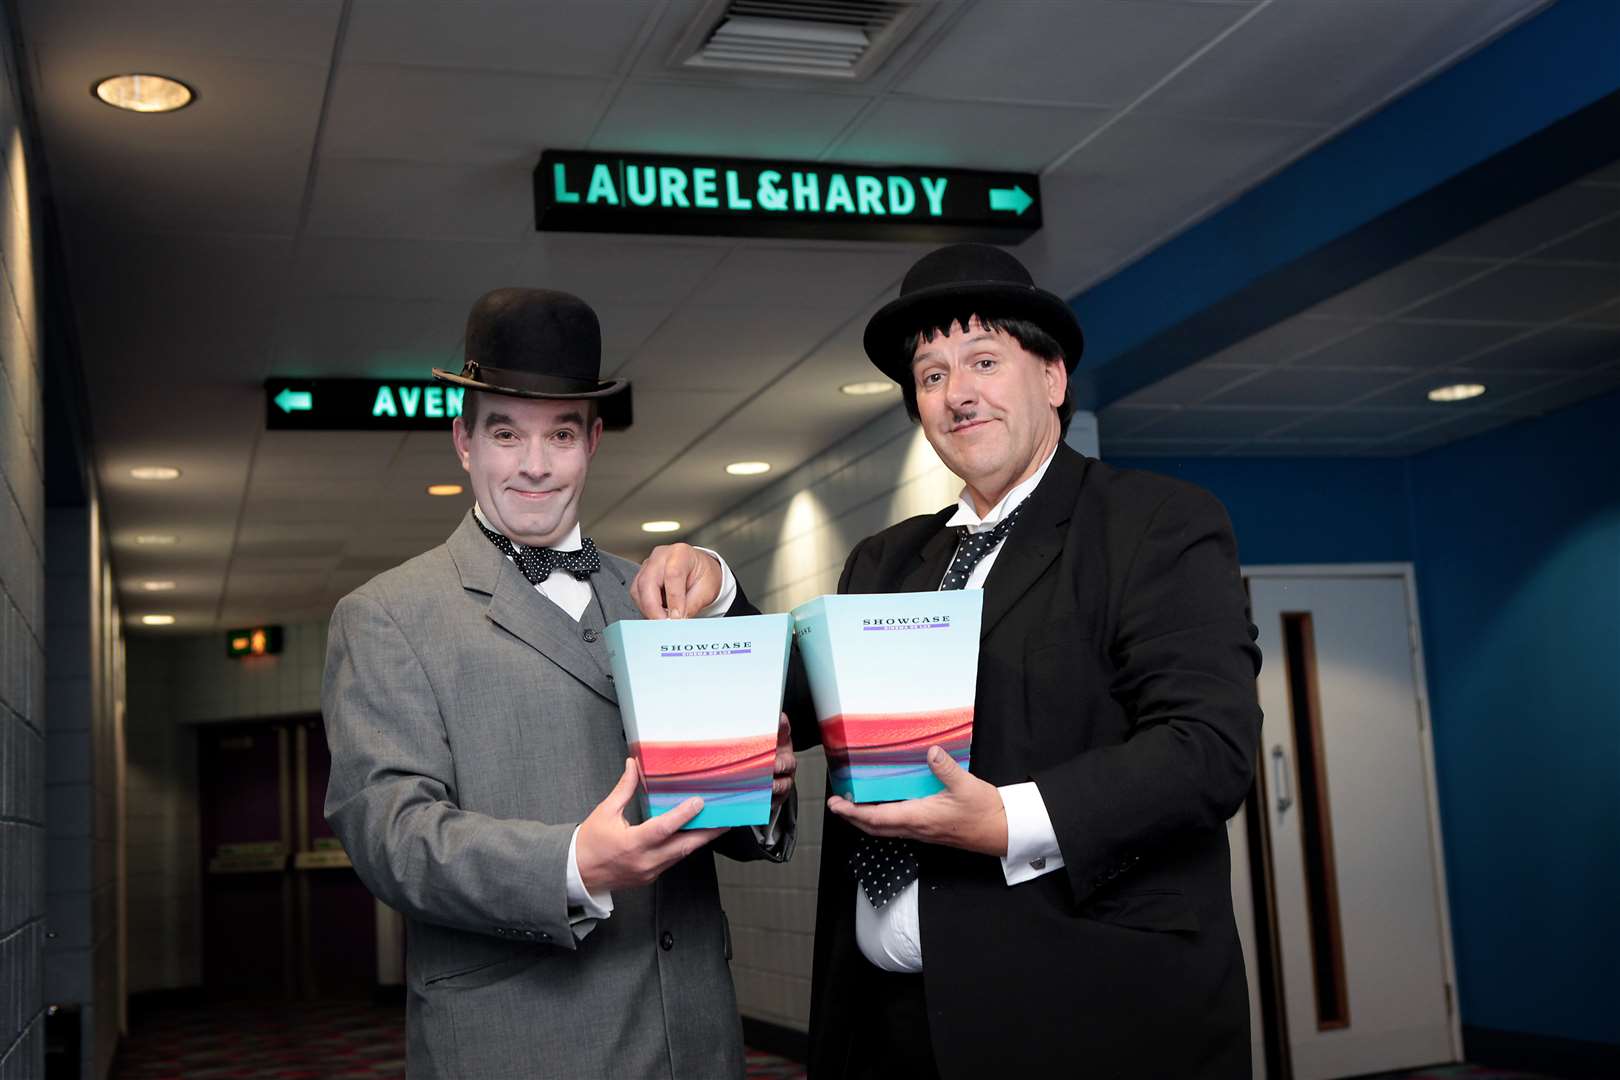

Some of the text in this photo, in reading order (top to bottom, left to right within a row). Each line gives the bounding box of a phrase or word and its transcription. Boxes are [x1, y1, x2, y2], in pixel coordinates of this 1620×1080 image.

[554, 163, 948, 216] LAUREL&HARDY
[863, 616, 950, 625] SHOWCASE
[661, 642, 752, 652] SHOWCASE
